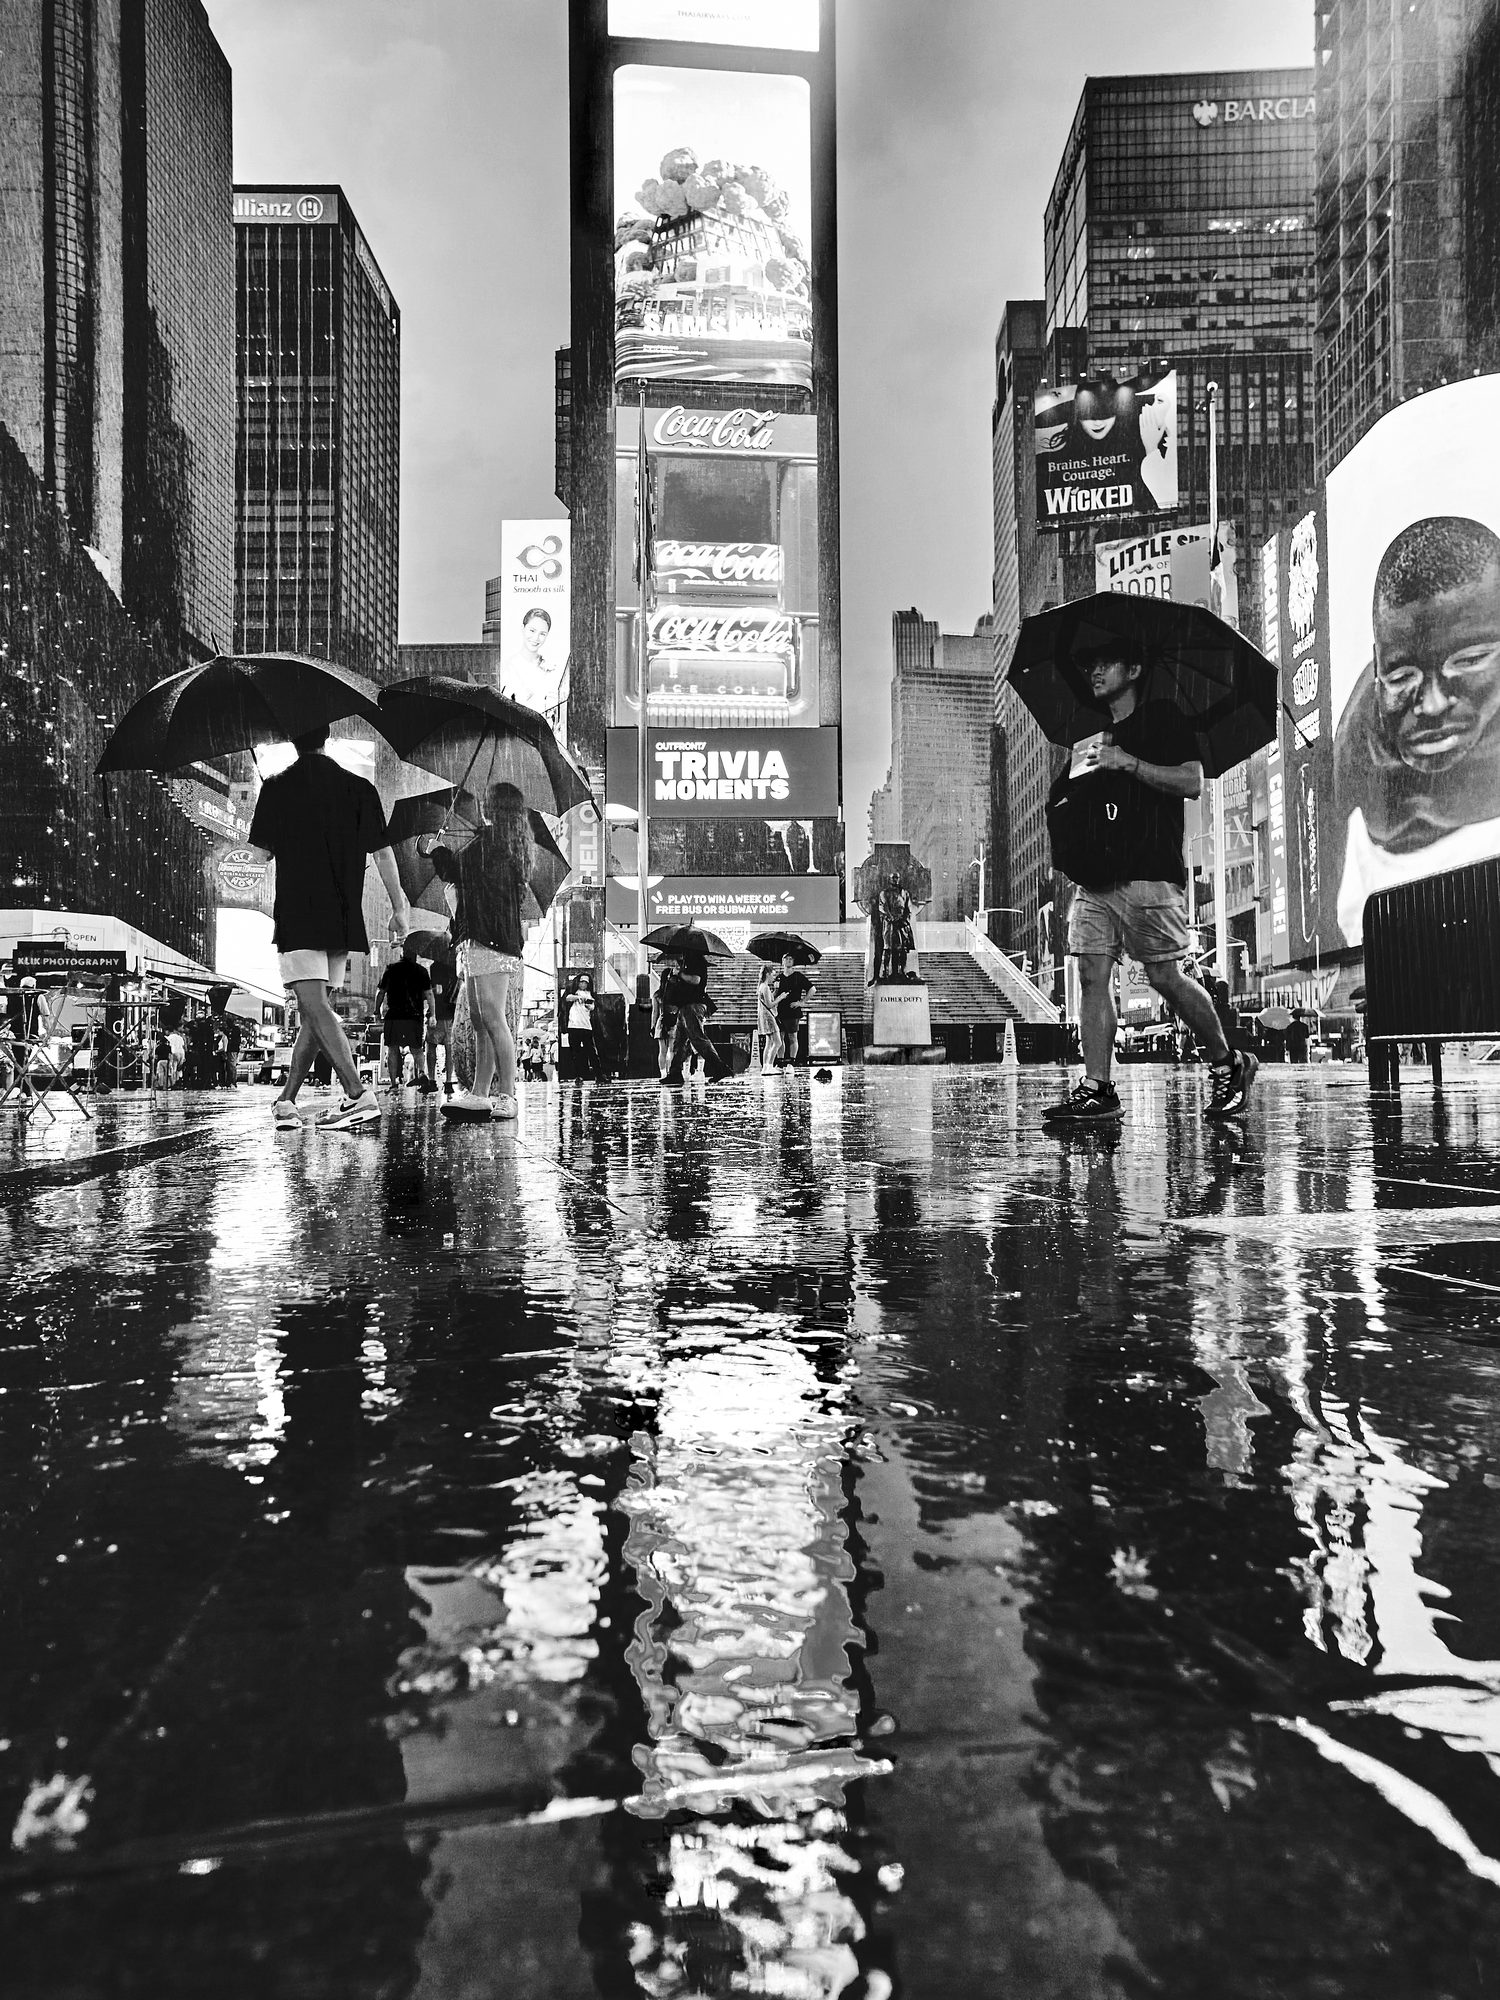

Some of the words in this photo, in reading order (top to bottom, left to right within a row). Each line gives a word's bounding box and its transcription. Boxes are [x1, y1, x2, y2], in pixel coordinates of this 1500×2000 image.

[653, 405, 781, 450] Coca-Cola
[1048, 459, 1090, 473] Brains.
[1092, 453, 1131, 467] Heart.
[1062, 468, 1116, 482] Courage.
[1109, 535, 1171, 579] LITTLE
[512, 574, 538, 582] THAI
[513, 585, 542, 593] Smooth
[553, 584, 566, 593] silk
[647, 605, 792, 653] Coca-Cola
[660, 683, 698, 694] ICE
[717, 685, 777, 696] COLD
[655, 750, 790, 779] TRIVIA
[655, 778, 790, 800] MOMENTS
[1269, 773, 1284, 841] COME
[579, 804, 598, 882] HELLO
[668, 894, 692, 904] PLAY
[693, 894, 705, 904] TO
[708, 894, 726, 904] WIN
[726, 894, 734, 904] A
[735, 894, 761, 904] WEEK
[762, 894, 776, 904] OF
[655, 905, 681, 914] FREE
[682, 905, 702, 914] BUS
[703, 905, 717, 914] OR
[718, 905, 758, 914] SUBWAY
[759, 905, 789, 914] RIDES
[73, 933, 97, 942] OPEN
[17, 956, 40, 966] KLIK
[43, 957, 120, 966] PHOTOGRAPHY
